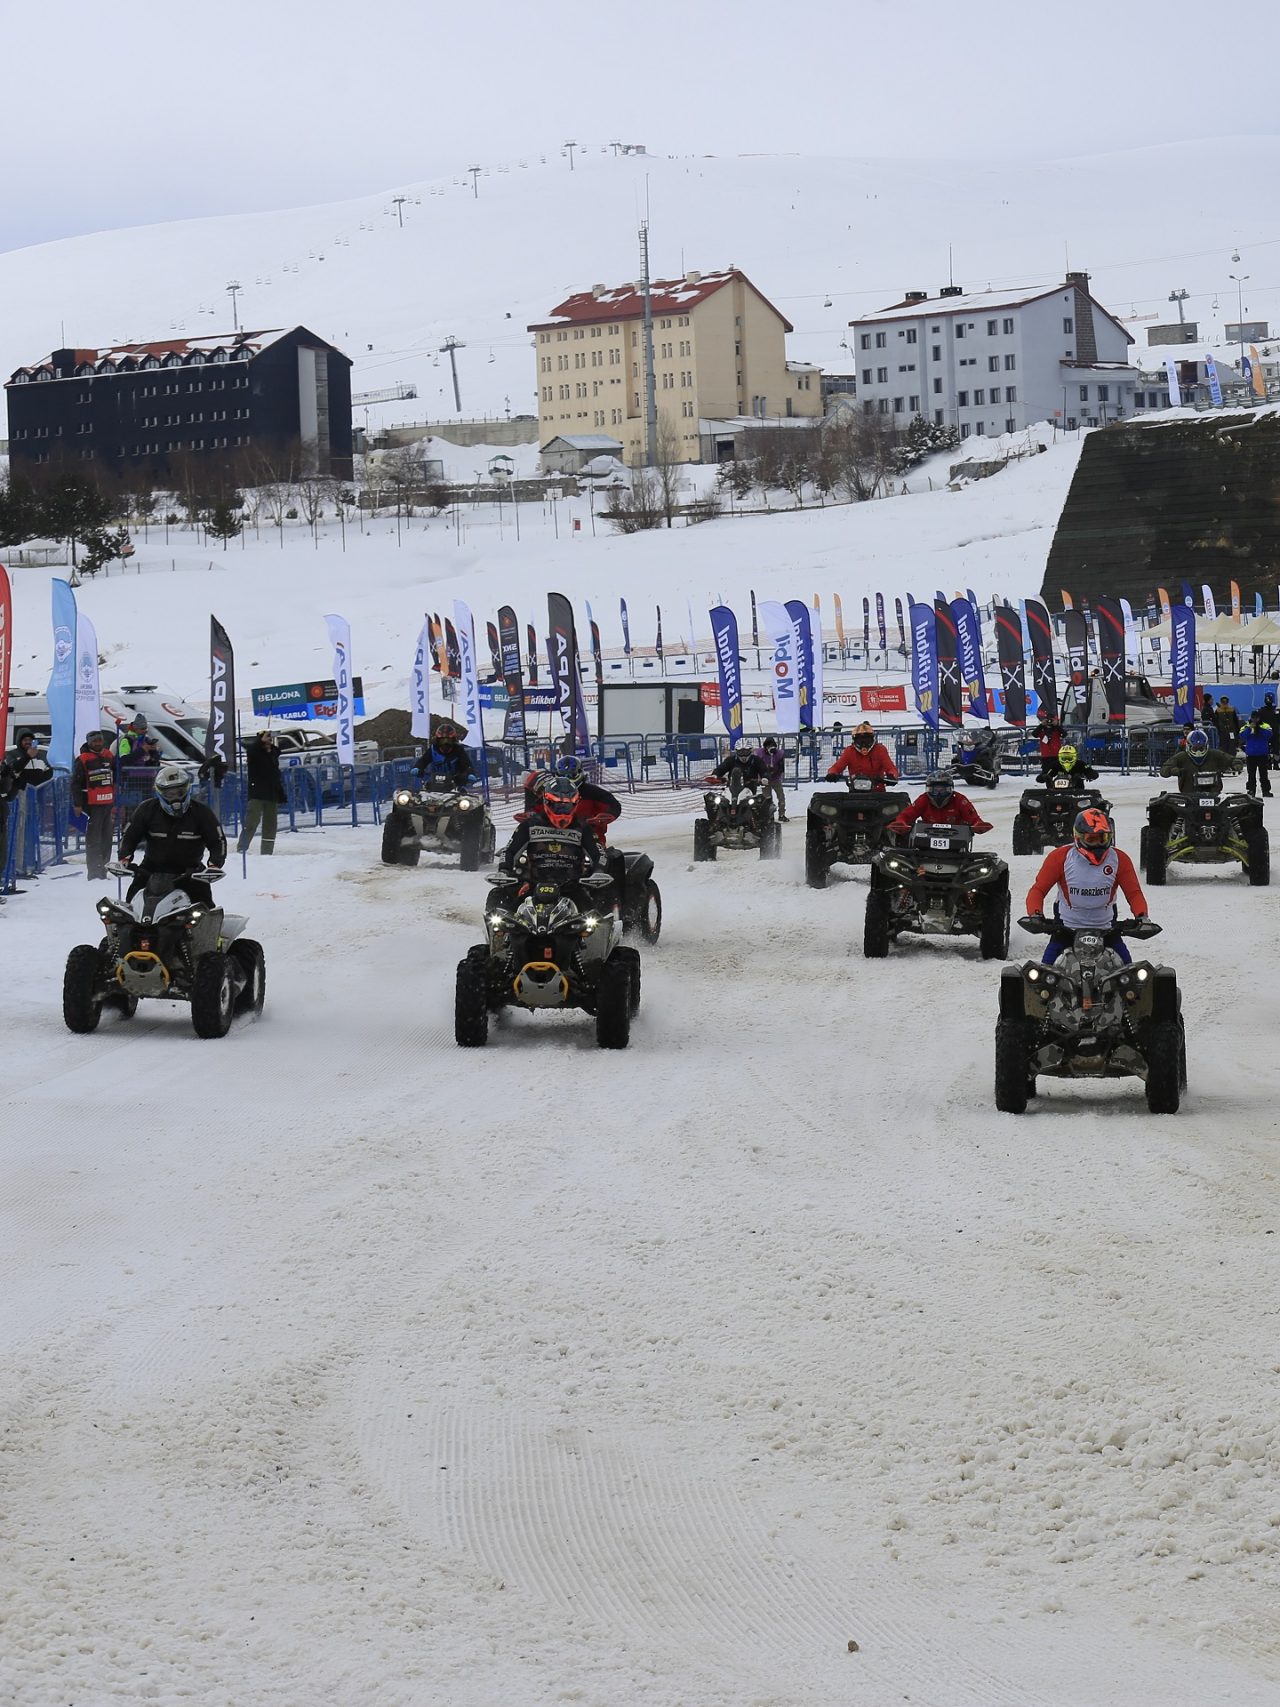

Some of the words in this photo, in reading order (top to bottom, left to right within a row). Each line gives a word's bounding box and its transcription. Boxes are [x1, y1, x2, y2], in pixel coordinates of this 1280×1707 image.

[257, 690, 300, 702] BELLONA
[494, 694, 509, 702] BELL
[822, 694, 858, 704] PORTOTO
[314, 702, 338, 717] Erci
[932, 839, 948, 848] 851
[539, 886, 554, 894] 933
[1069, 886, 1080, 896] ATV
